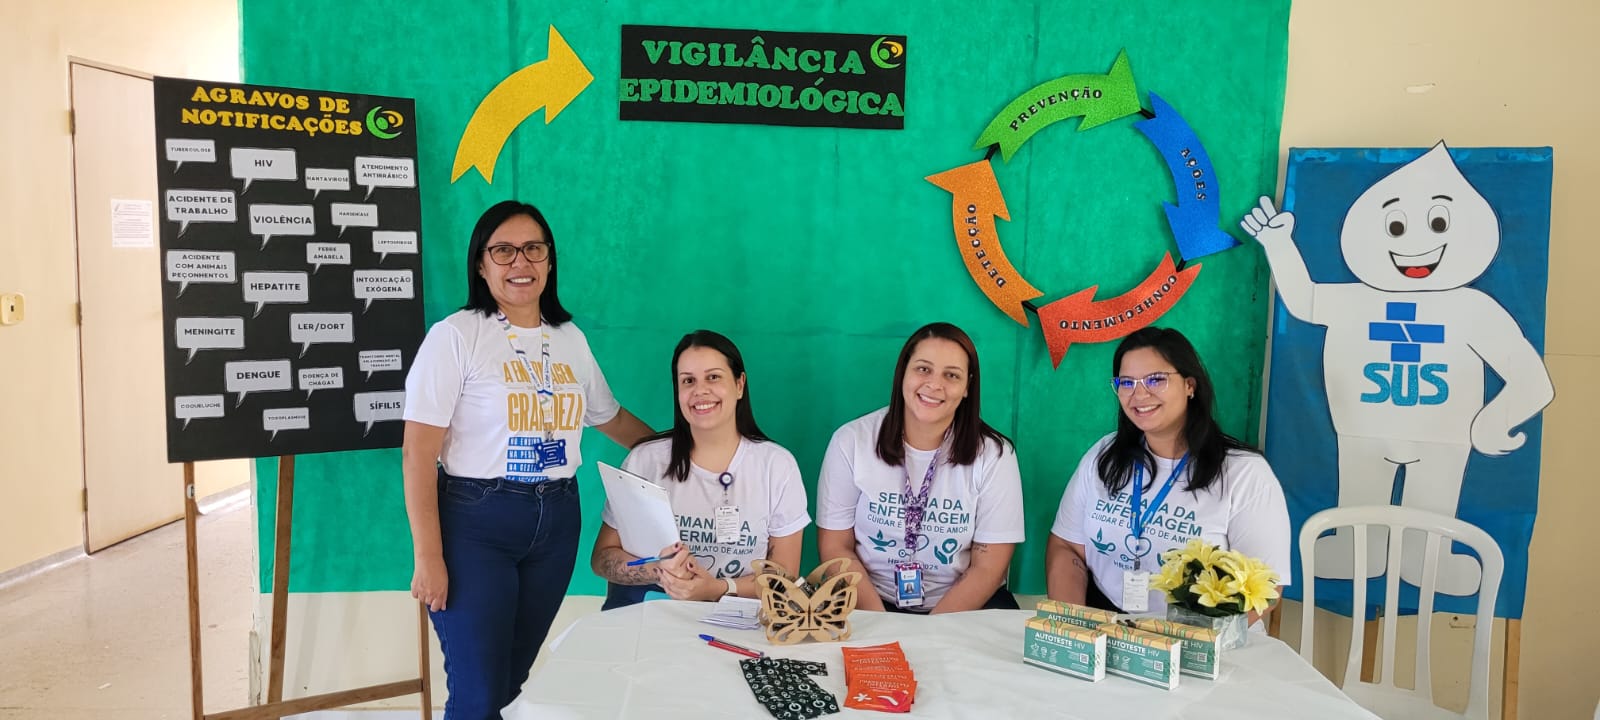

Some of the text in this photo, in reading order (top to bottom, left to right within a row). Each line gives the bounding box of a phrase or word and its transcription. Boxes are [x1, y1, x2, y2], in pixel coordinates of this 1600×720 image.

[641, 36, 866, 74] VIGILÂNCIA
[191, 86, 350, 114] AGRAVOS DE
[619, 77, 904, 116] EPIDEMIOLÓGICA
[1009, 86, 1103, 132] PREVENÇÃO
[181, 108, 363, 137] NOTIFICAÇÕES
[254, 159, 273, 168] HIV
[1180, 147, 1207, 201] AÇÕES
[169, 195, 233, 204] ACIDENTE DE
[175, 207, 229, 215] TRABALHO
[253, 213, 313, 225] VIOLÊNCIA
[965, 204, 1007, 289] DETECÇÃO
[172, 272, 229, 280] PEÇONHENTOS
[356, 275, 412, 283] INTOXICAÇÃO
[250, 282, 301, 291] HEPATITE
[366, 284, 403, 293] EXÓGENA
[1059, 274, 1177, 331] CONHECIMENTO
[184, 327, 236, 336] MENINGITE
[297, 322, 345, 332] LER/DORT
[236, 370, 281, 380] DENGUE
[1360, 362, 1449, 406] SUS
[369, 400, 401, 411] SÍFILIS
[943, 499, 963, 511] DA
[1173, 506, 1196, 521] DA
[867, 514, 895, 528] CUIDAR
[934, 526, 944, 534] DE
[947, 525, 969, 534] AMOR
[1091, 512, 1118, 526] CUIDAR
[1158, 530, 1169, 540] DE
[1048, 613, 1088, 627] AUTOTESTE
[1034, 631, 1086, 650] AUTOTESTE HIV
[1190, 641, 1204, 649] HIV
[1147, 648, 1160, 657] HIV
